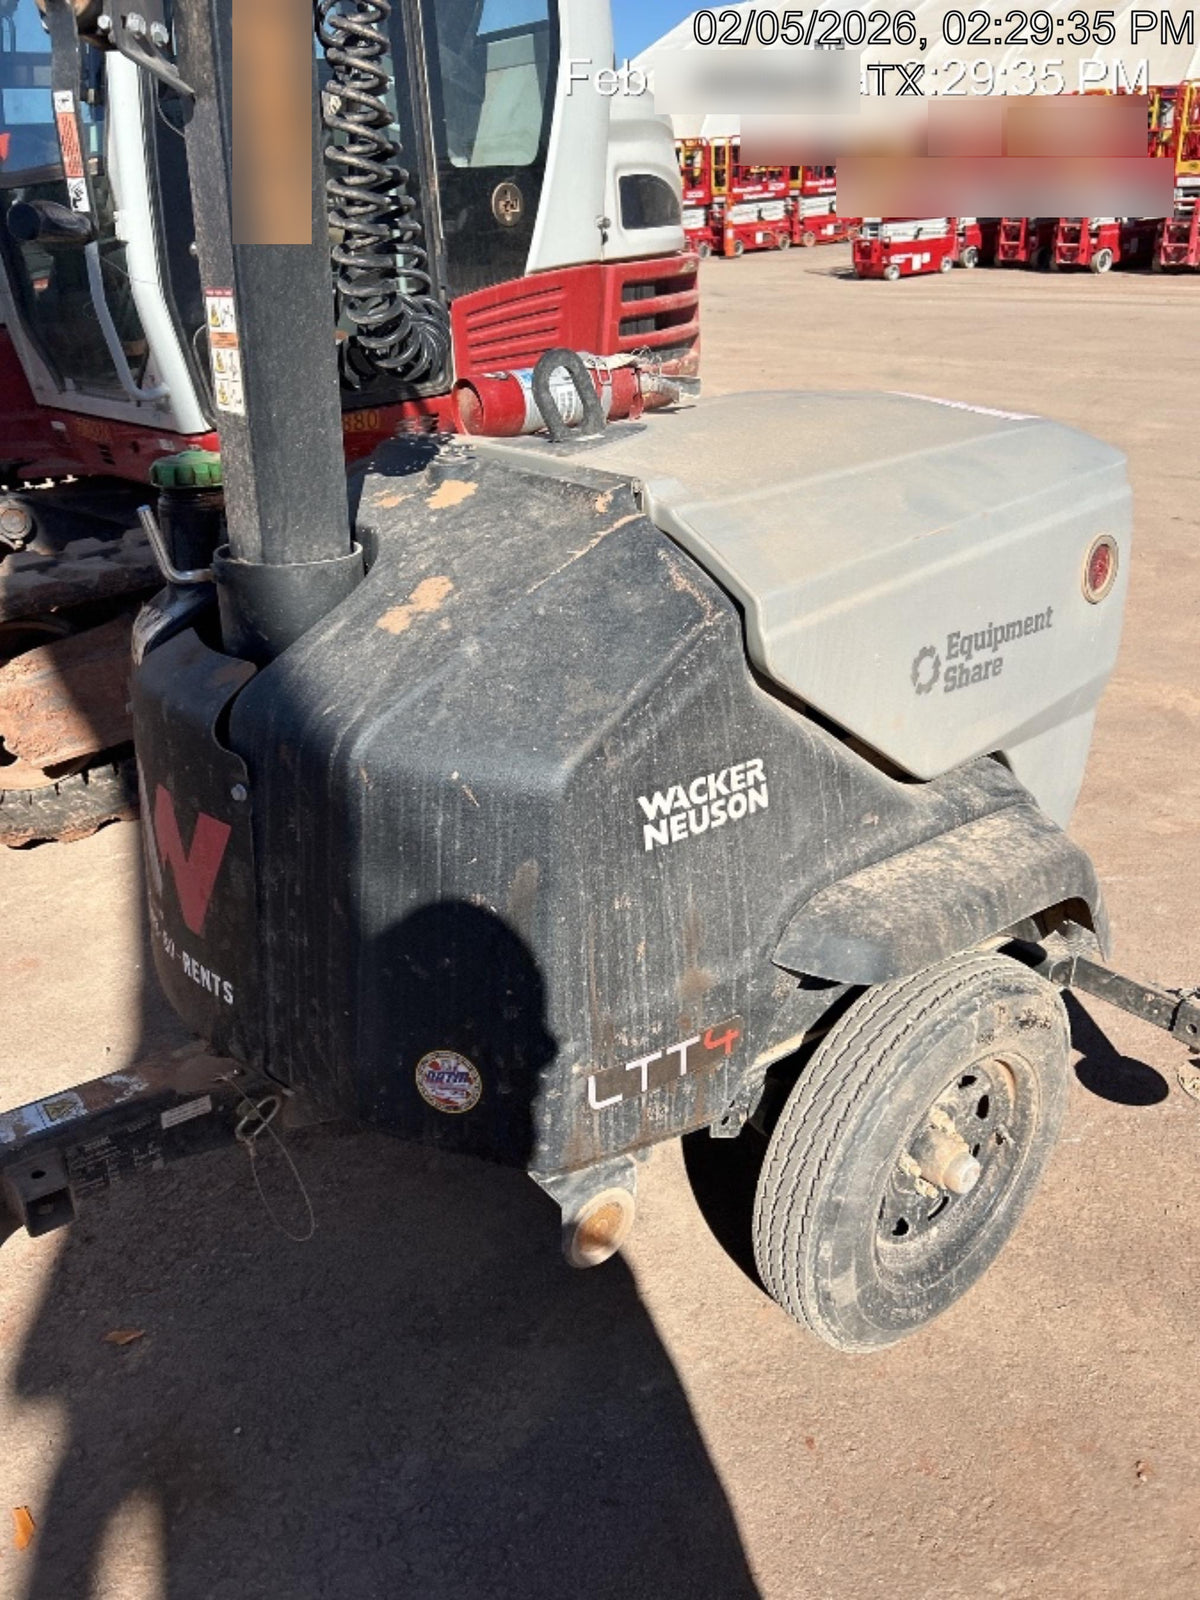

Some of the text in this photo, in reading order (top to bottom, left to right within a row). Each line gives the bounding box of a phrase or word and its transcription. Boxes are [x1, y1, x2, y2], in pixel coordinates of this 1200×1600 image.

[945, 605, 1054, 662] Equipment
[943, 656, 1004, 693] Share
[637, 758, 767, 821] WACKER
[643, 782, 769, 852] NEUSON
[587, 1028, 740, 1110] LTT4
